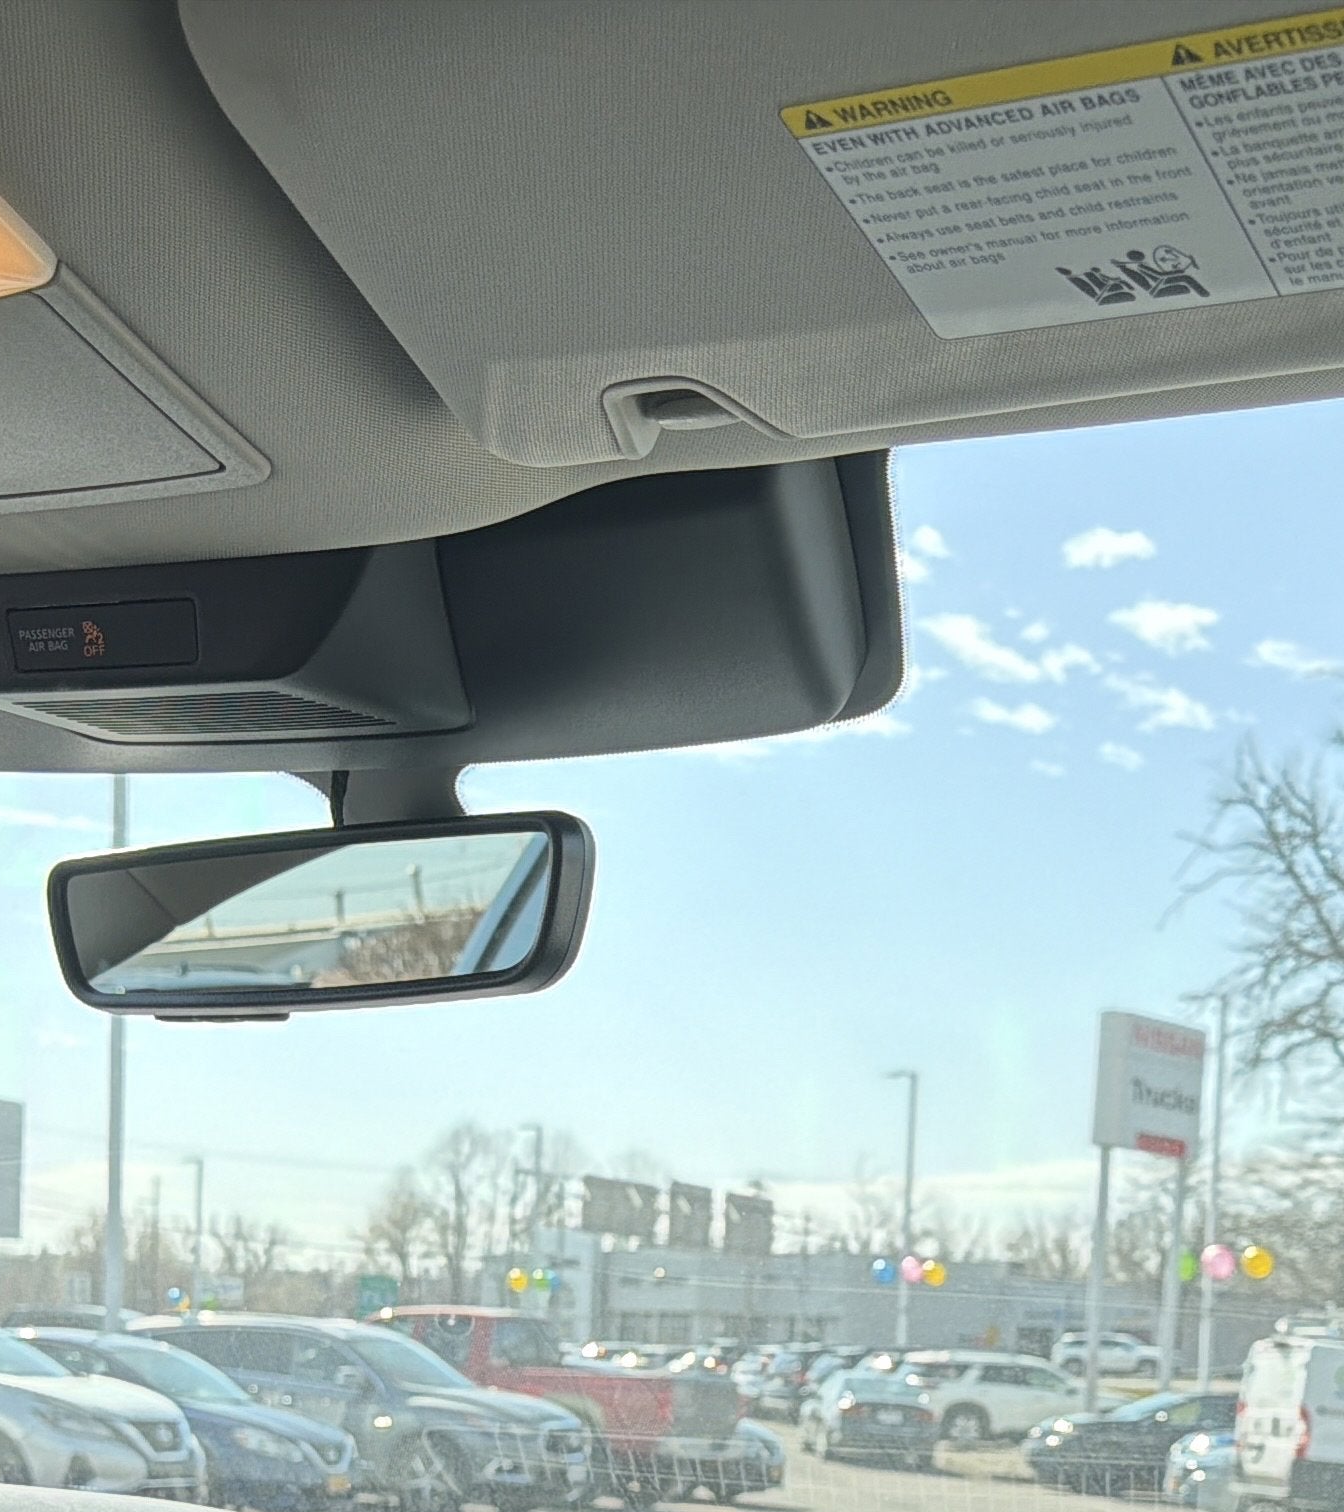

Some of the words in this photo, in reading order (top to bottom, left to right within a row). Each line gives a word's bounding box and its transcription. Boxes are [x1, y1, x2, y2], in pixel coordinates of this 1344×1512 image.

[1178, 70, 1239, 92] MÊME
[1243, 60, 1296, 82] AVEC
[1298, 51, 1342, 72] DES
[832, 89, 952, 123] WARNING
[1188, 75, 1318, 109] GONFLABLES
[811, 135, 867, 155] EVEN
[866, 126, 919, 146] WITH
[924, 107, 1034, 137] ADVANCED
[1040, 99, 1075, 116] AIR
[1079, 88, 1140, 110] BAGS
[18, 628, 75, 640] PASSENGER
[28, 642, 45, 652] AIR
[48, 640, 68, 652] BAG
[83, 645, 105, 657] OFF
